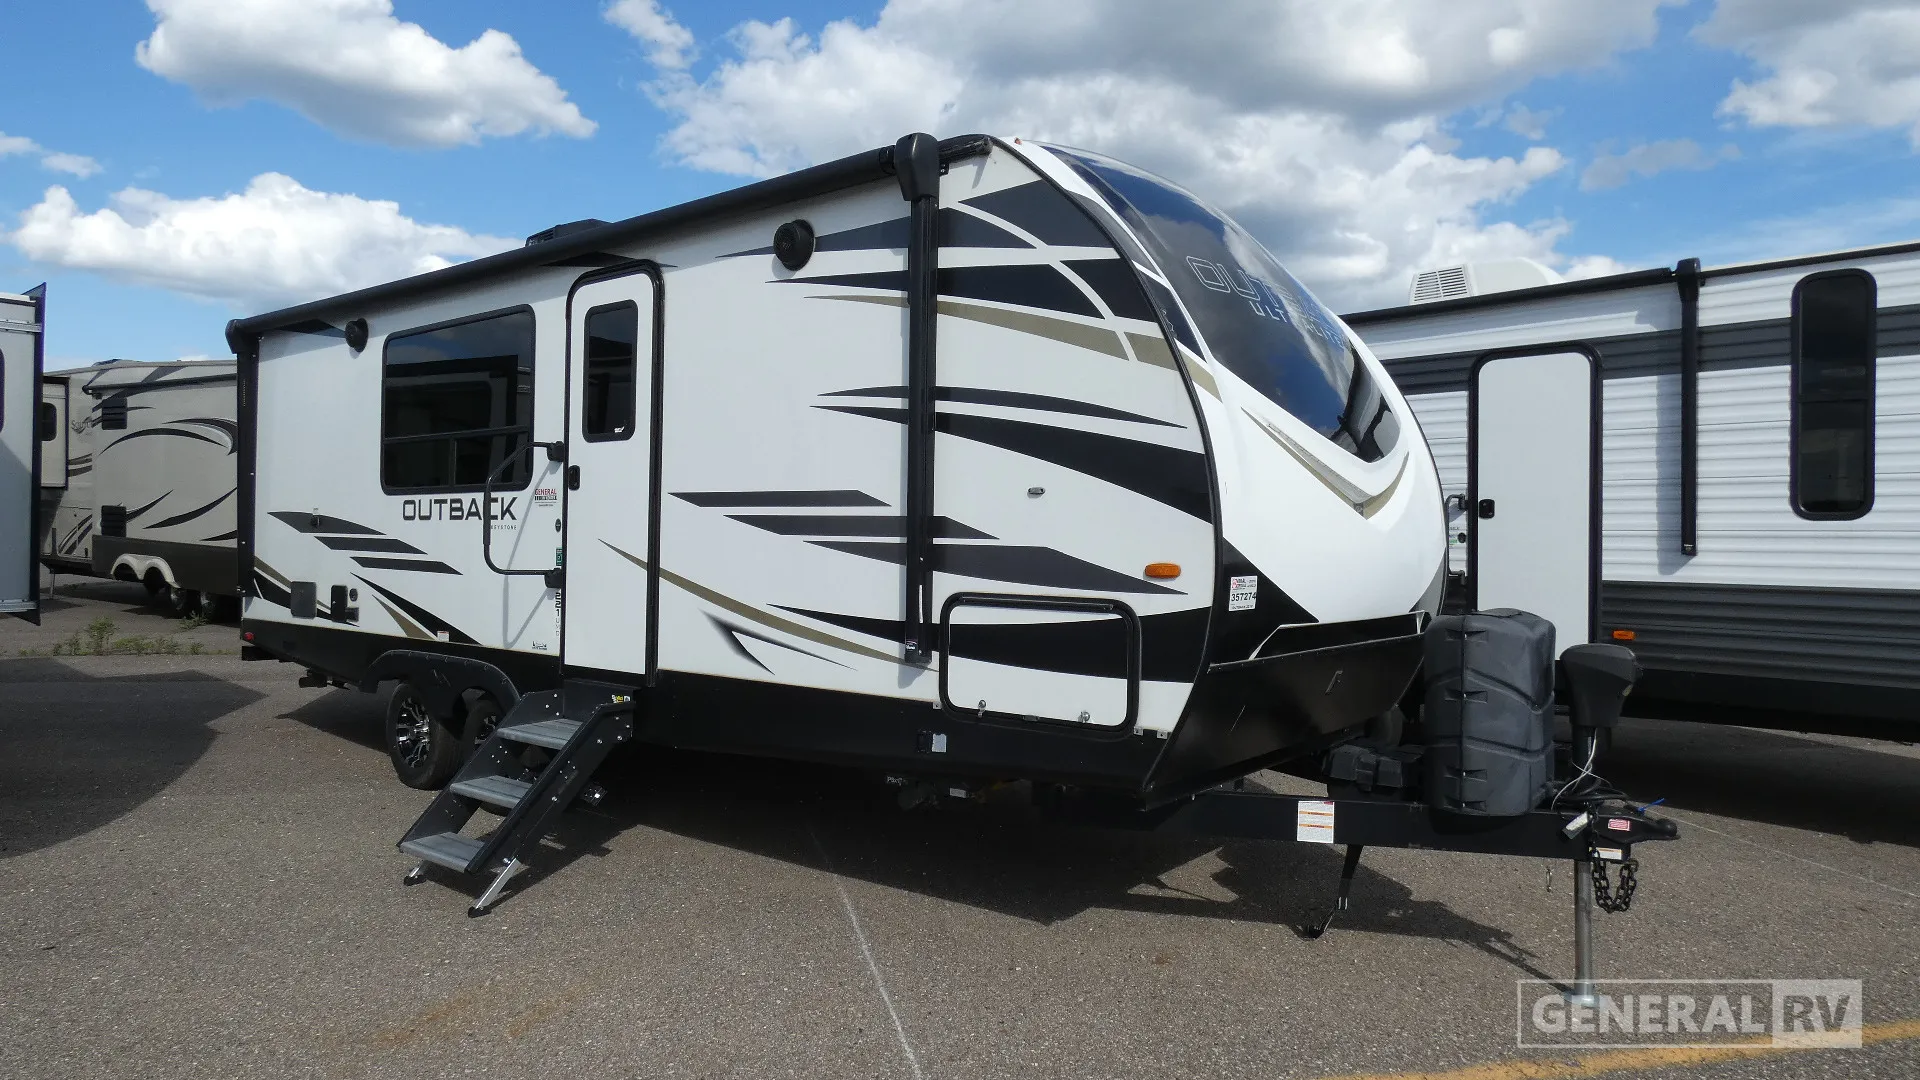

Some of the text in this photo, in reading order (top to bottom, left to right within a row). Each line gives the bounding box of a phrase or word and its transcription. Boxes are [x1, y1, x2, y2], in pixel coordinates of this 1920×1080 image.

[1186, 255, 1343, 338] OUTBA
[402, 497, 518, 521] OUTBACK
[1231, 592, 1257, 602] 357274
